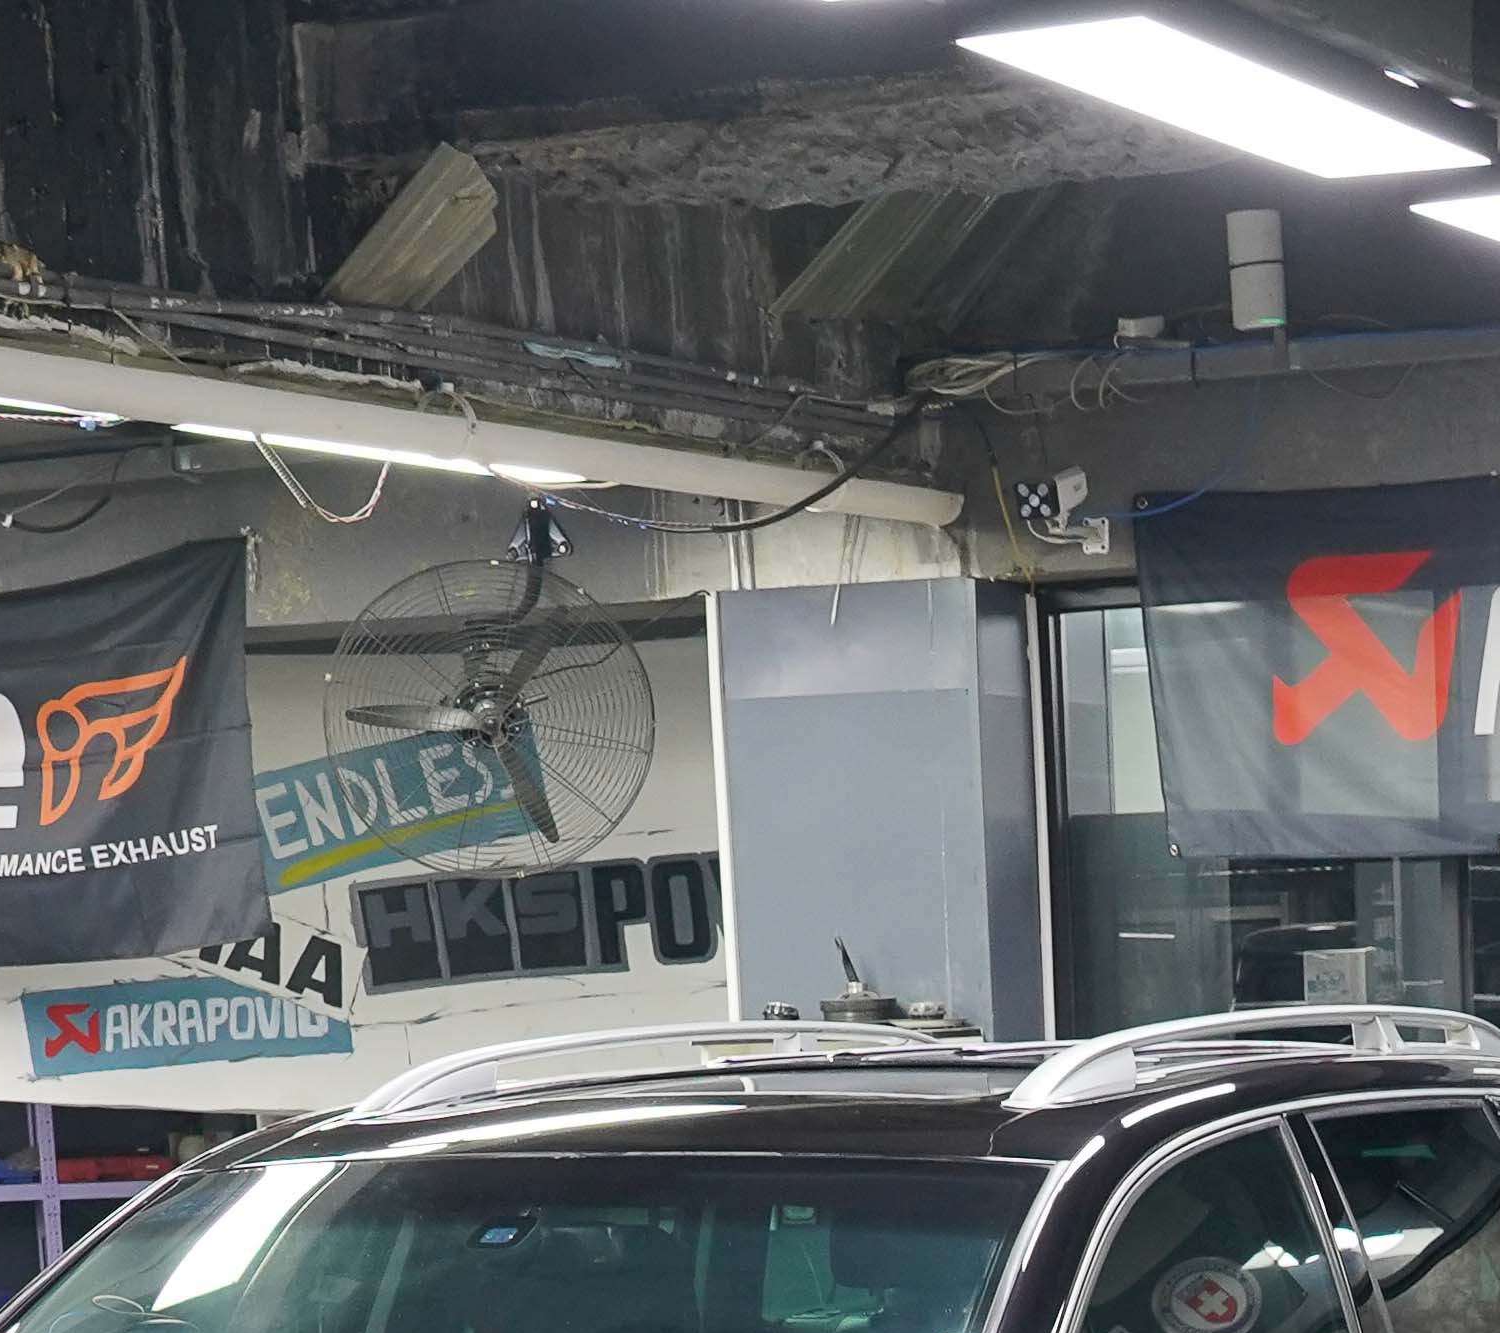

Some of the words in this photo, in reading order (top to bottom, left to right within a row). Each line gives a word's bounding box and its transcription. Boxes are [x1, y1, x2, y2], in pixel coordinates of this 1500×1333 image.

[92, 824, 219, 869] EXHAUST
[255, 741, 513, 860] ENDLES
[590, 851, 722, 974] PO
